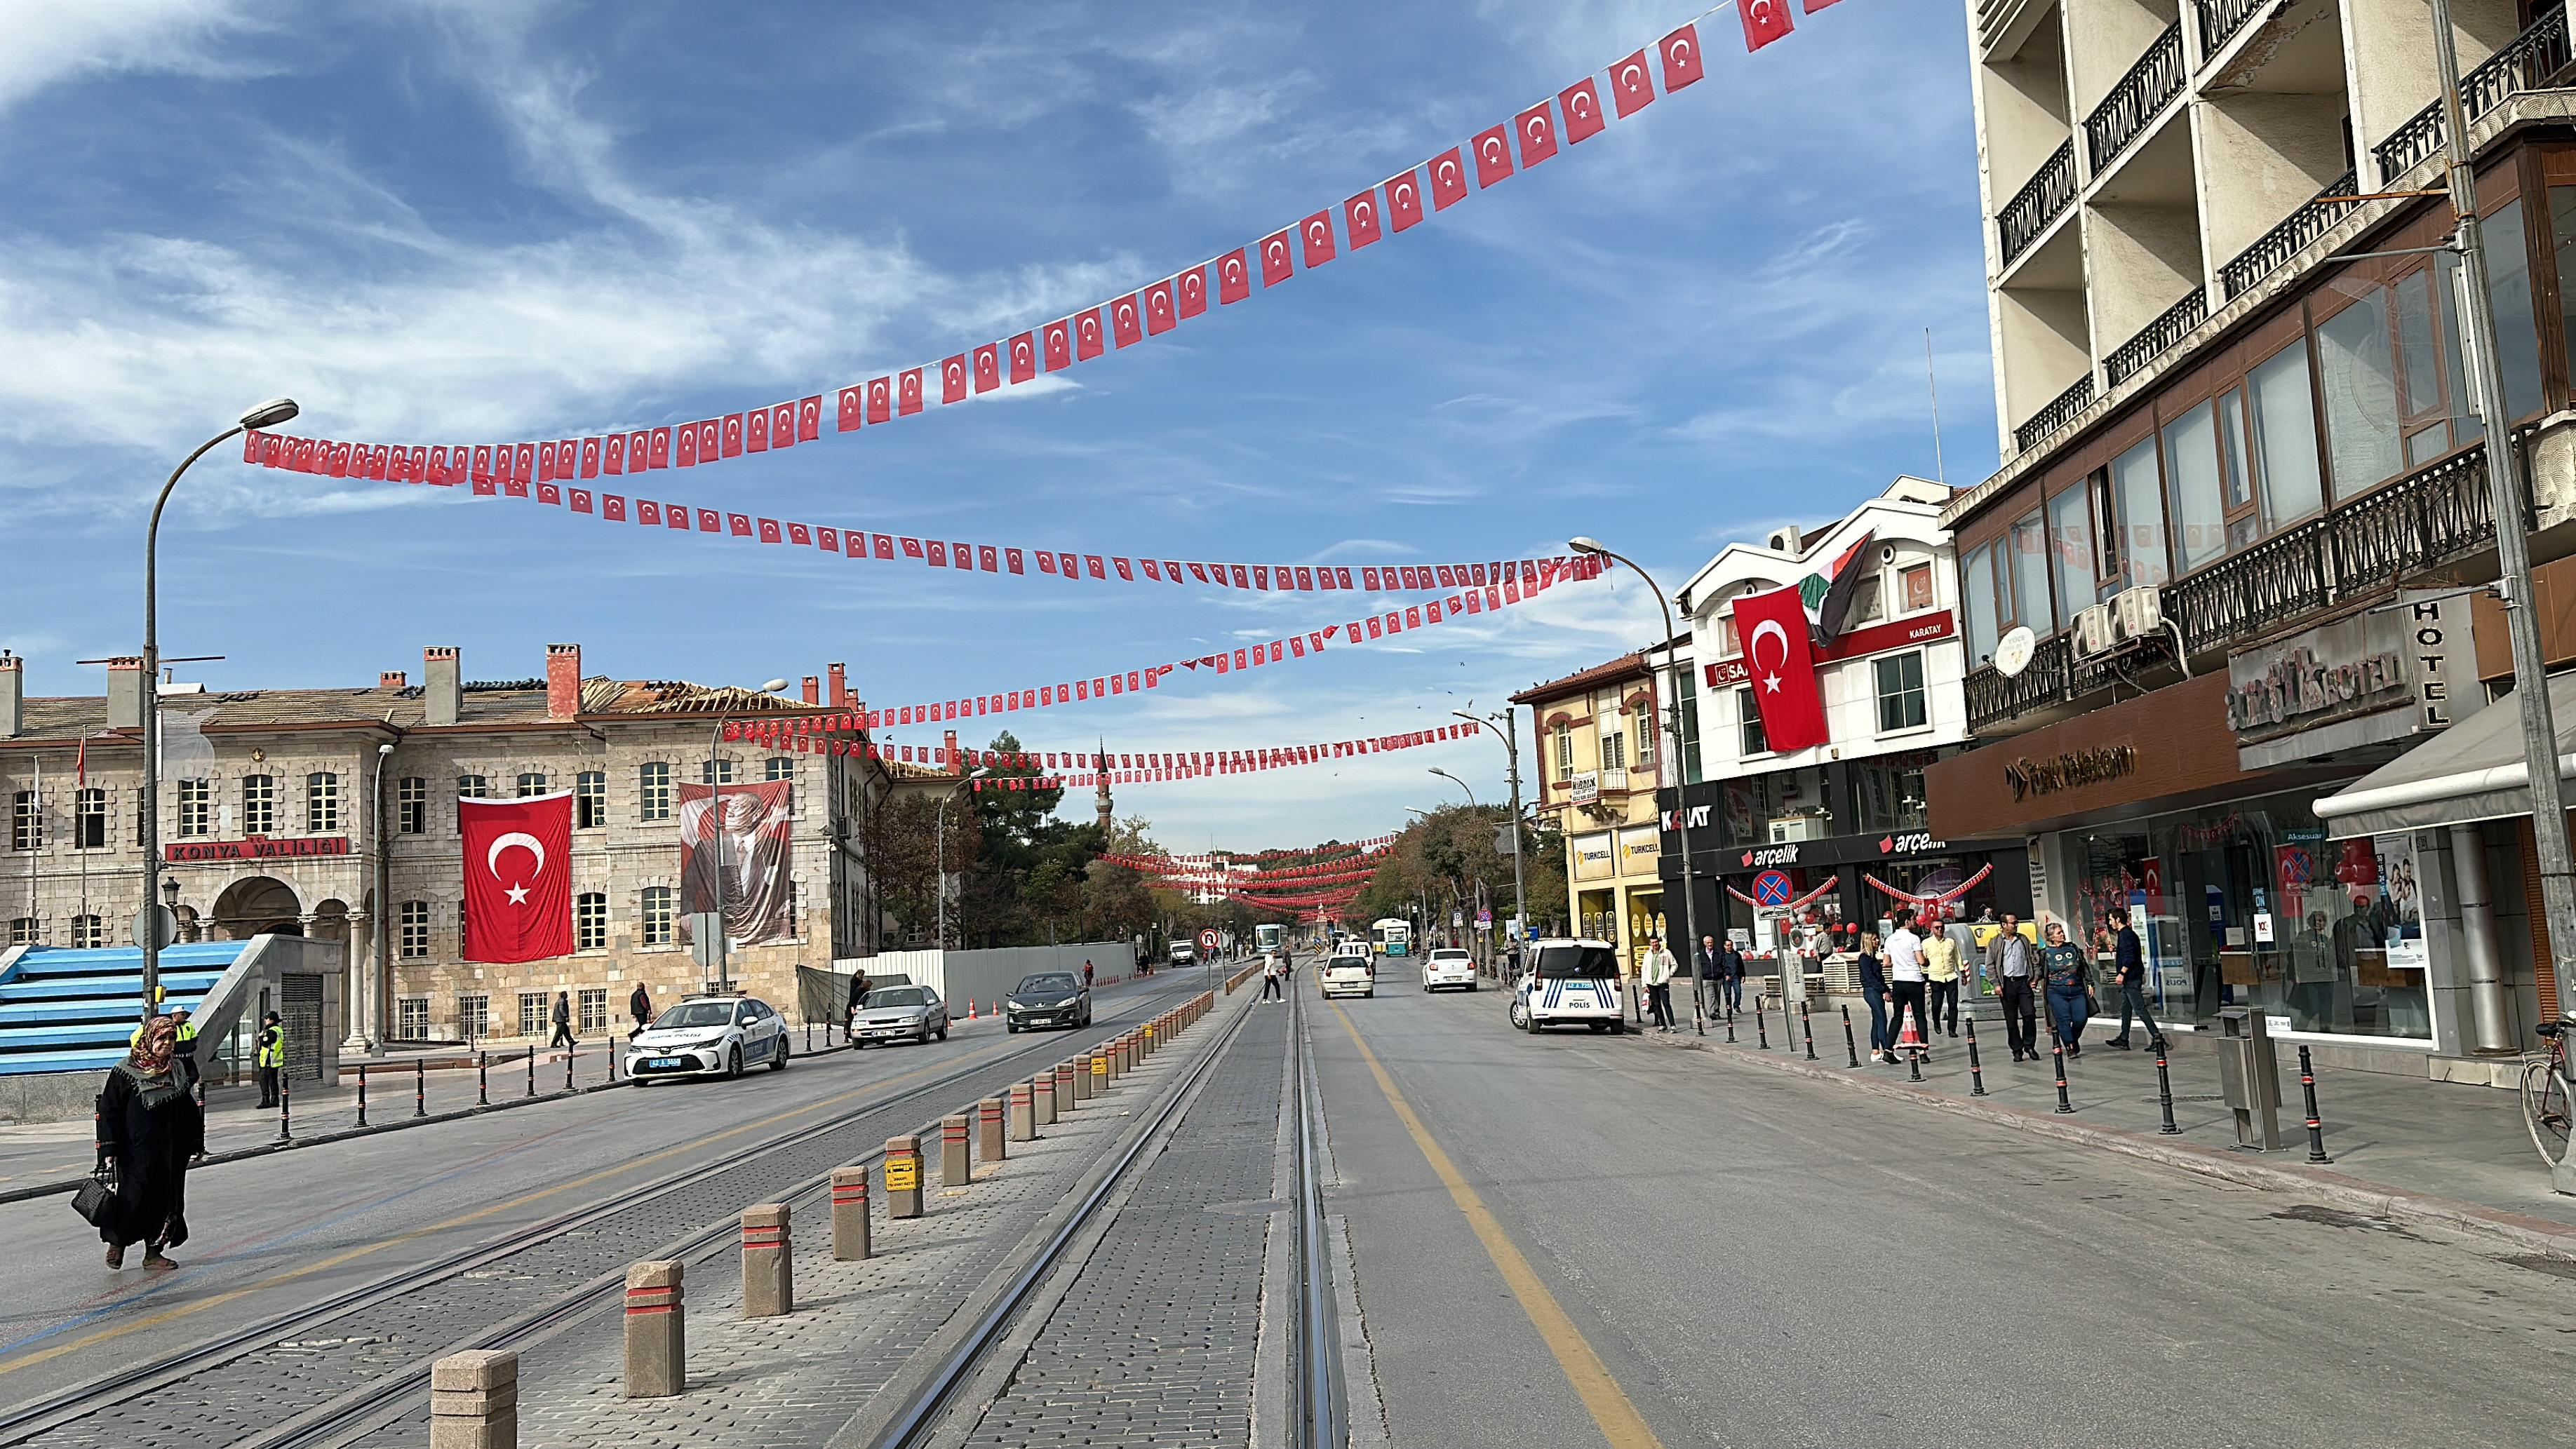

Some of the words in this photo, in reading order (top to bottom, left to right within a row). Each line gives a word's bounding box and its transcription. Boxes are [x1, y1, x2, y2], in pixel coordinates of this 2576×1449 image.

[1910, 624, 1941, 639] KARATAY
[1729, 663, 1748, 679] SA
[2413, 602, 2450, 725] HOTEL
[2288, 833, 2322, 841] Aksesuar
[173, 844, 241, 860] KONYA
[254, 838, 340, 856] VALİLİĞİ
[1583, 850, 1610, 861] TURKCELL
[1631, 844, 1660, 854] TURKCELL
[1755, 844, 1799, 868] arçelik
